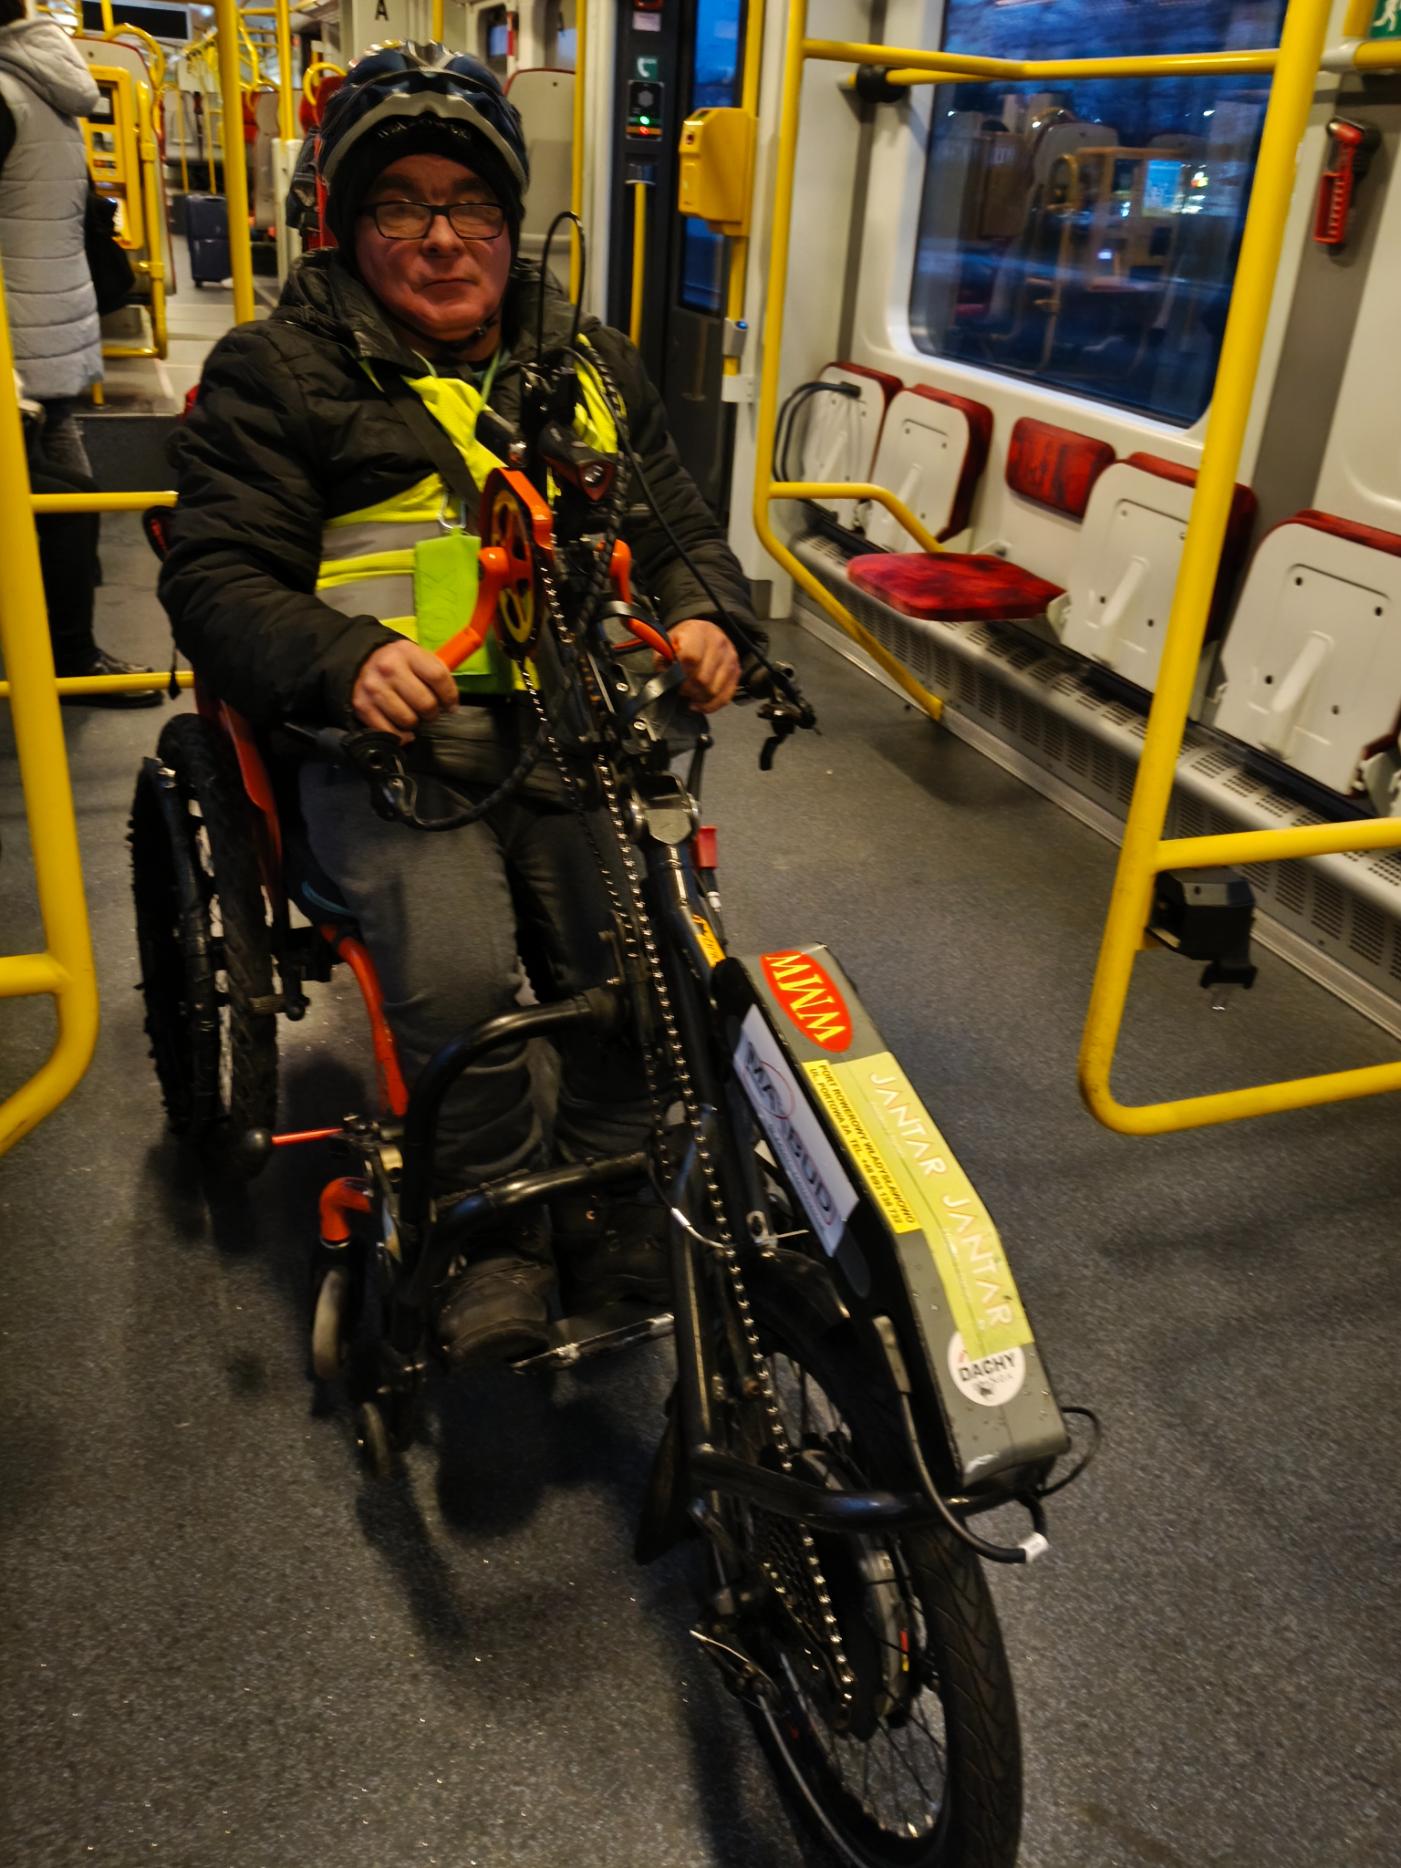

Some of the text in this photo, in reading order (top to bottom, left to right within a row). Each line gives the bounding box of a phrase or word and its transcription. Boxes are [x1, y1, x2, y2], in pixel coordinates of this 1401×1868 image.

[375, 0, 389, 20] A
[817, 1064, 837, 1087] PORT
[832, 1088, 868, 1141] ROWEROWY
[817, 1082, 846, 1123] PORTOWA
[870, 1071, 948, 1176] JANTAR
[943, 1194, 1013, 1326] JANTAR
[959, 1352, 1016, 1382] DACHY
